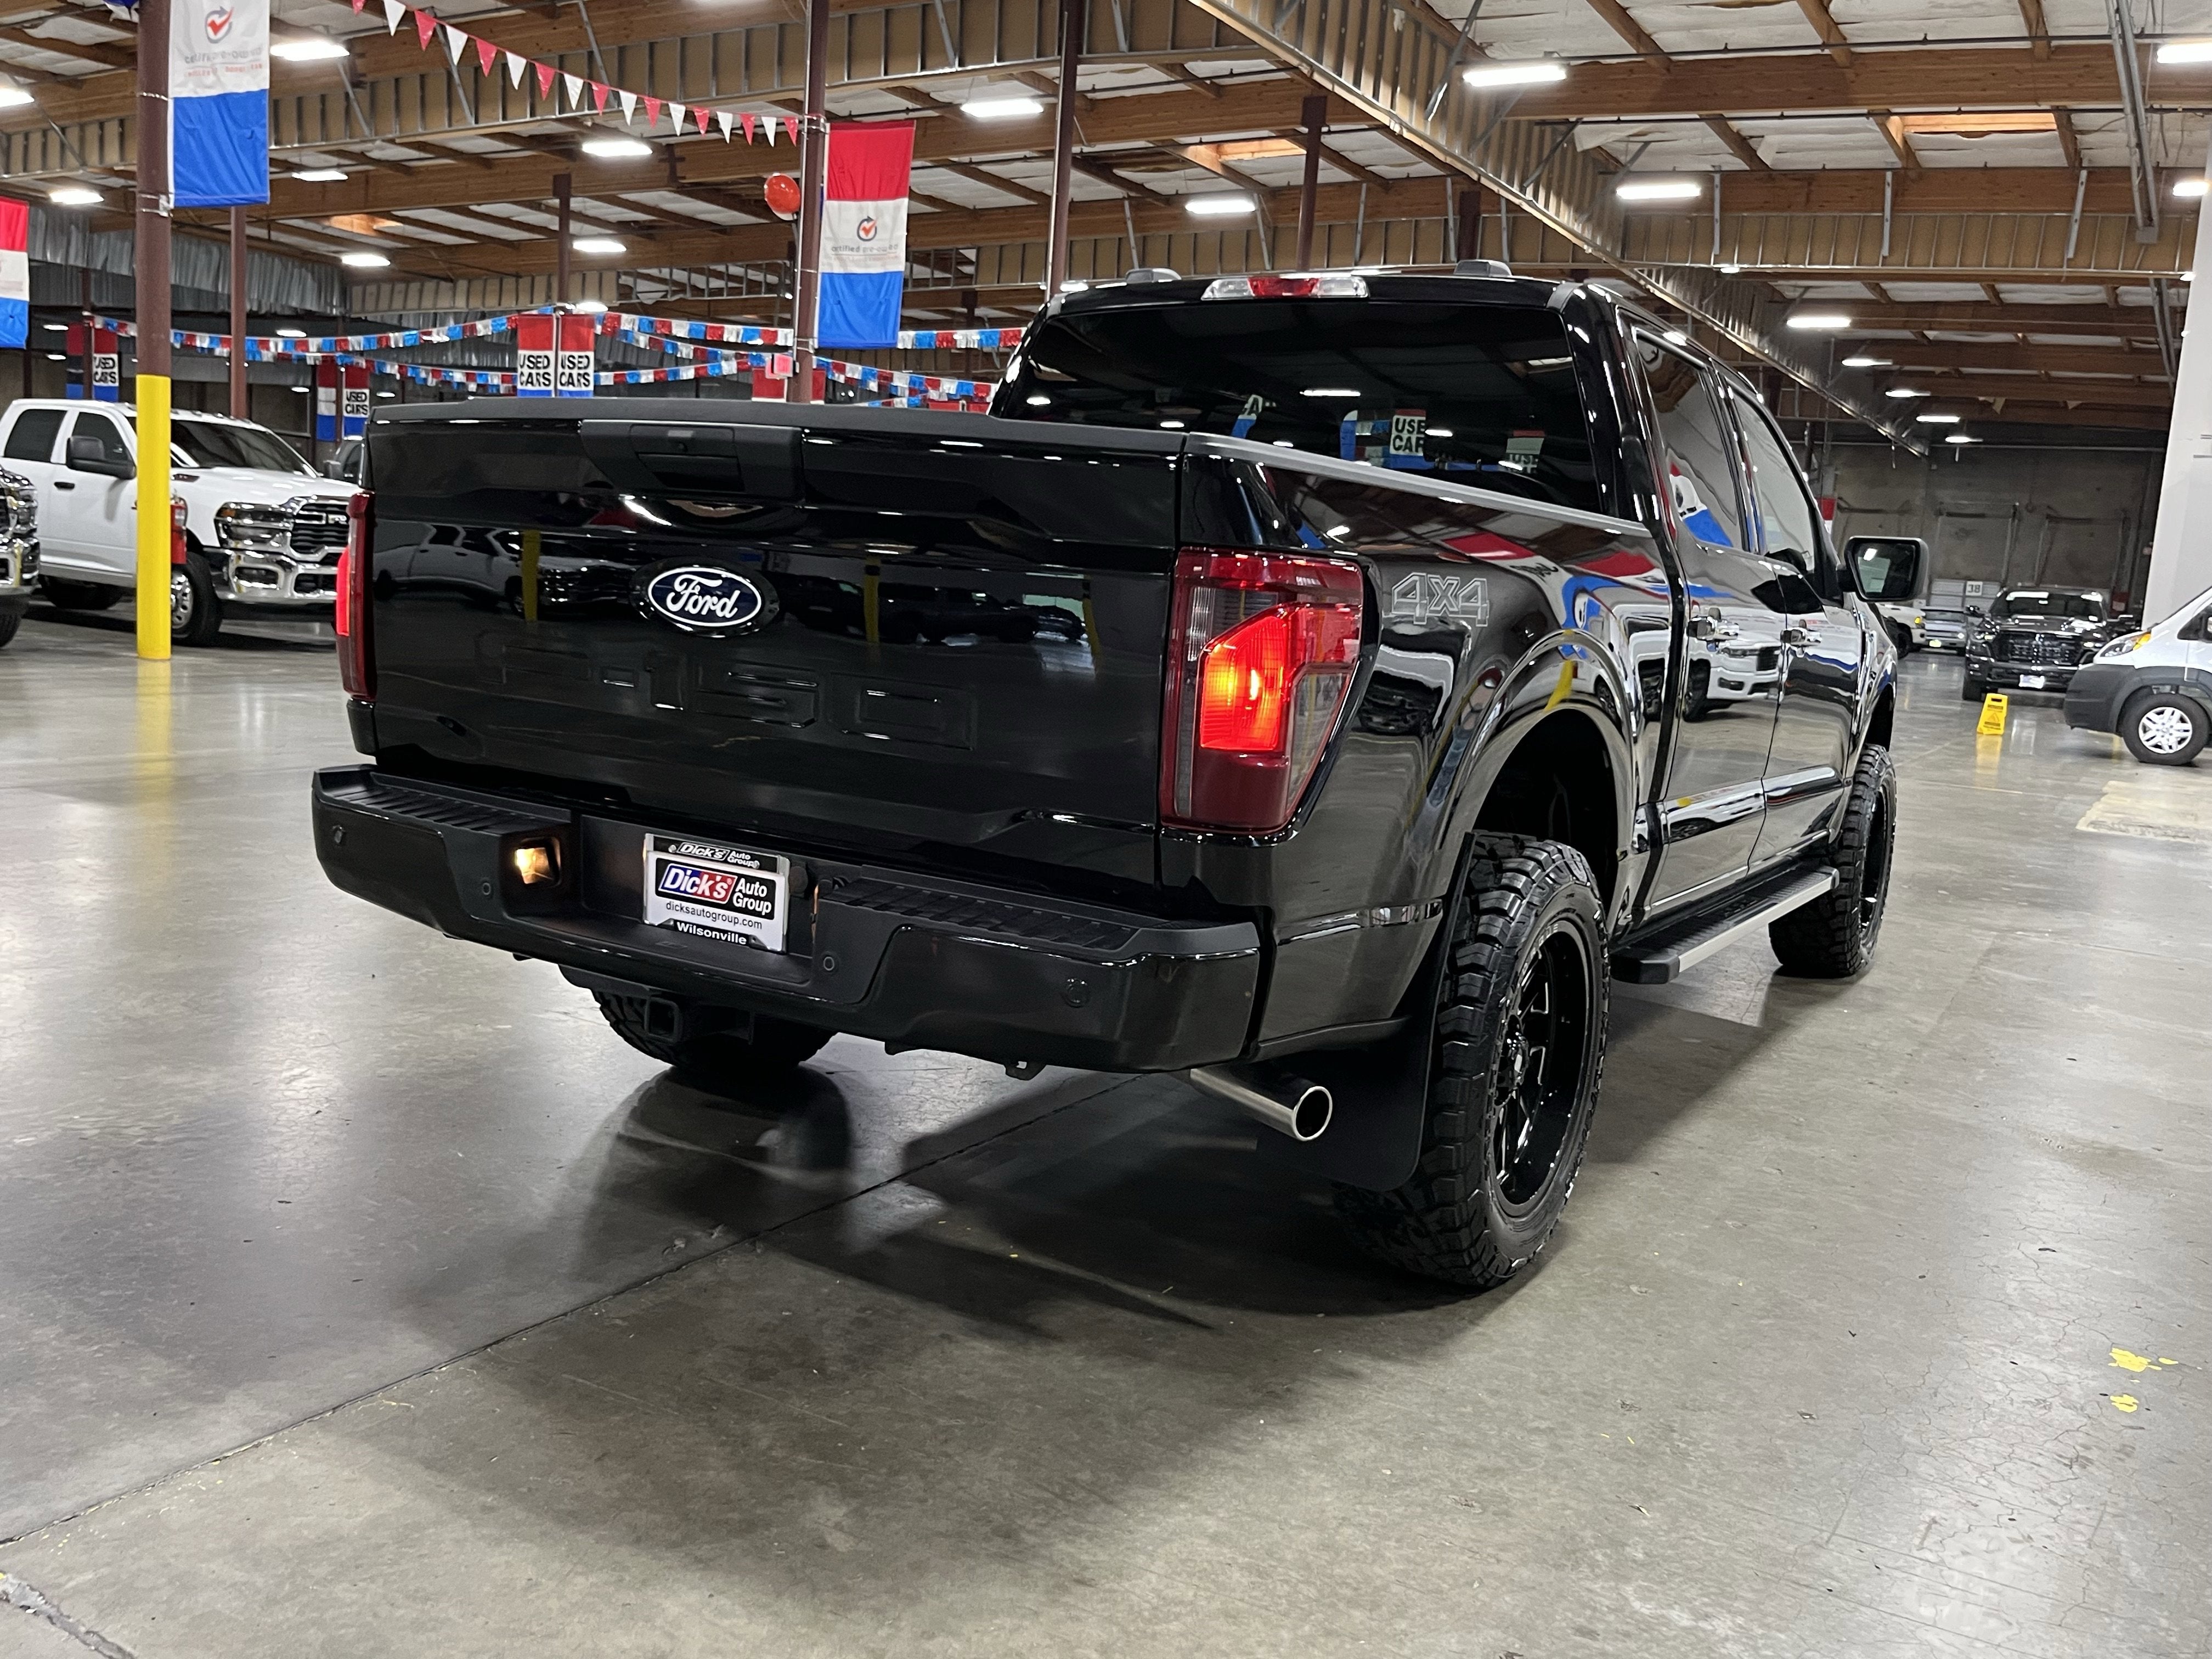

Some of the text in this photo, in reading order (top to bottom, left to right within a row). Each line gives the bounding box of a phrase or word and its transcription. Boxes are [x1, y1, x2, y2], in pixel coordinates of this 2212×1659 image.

[519, 354, 550, 369] USED
[561, 354, 590, 370] USED
[519, 371, 551, 387] CARS
[559, 371, 591, 387] CARS
[666, 574, 741, 618] Ford
[730, 851, 751, 860] Auto
[664, 867, 768, 899] Dick's Auto
[732, 892, 772, 916] Group
[666, 901, 763, 930] dicksautogroup.com
[676, 922, 747, 945] Wilsonville
